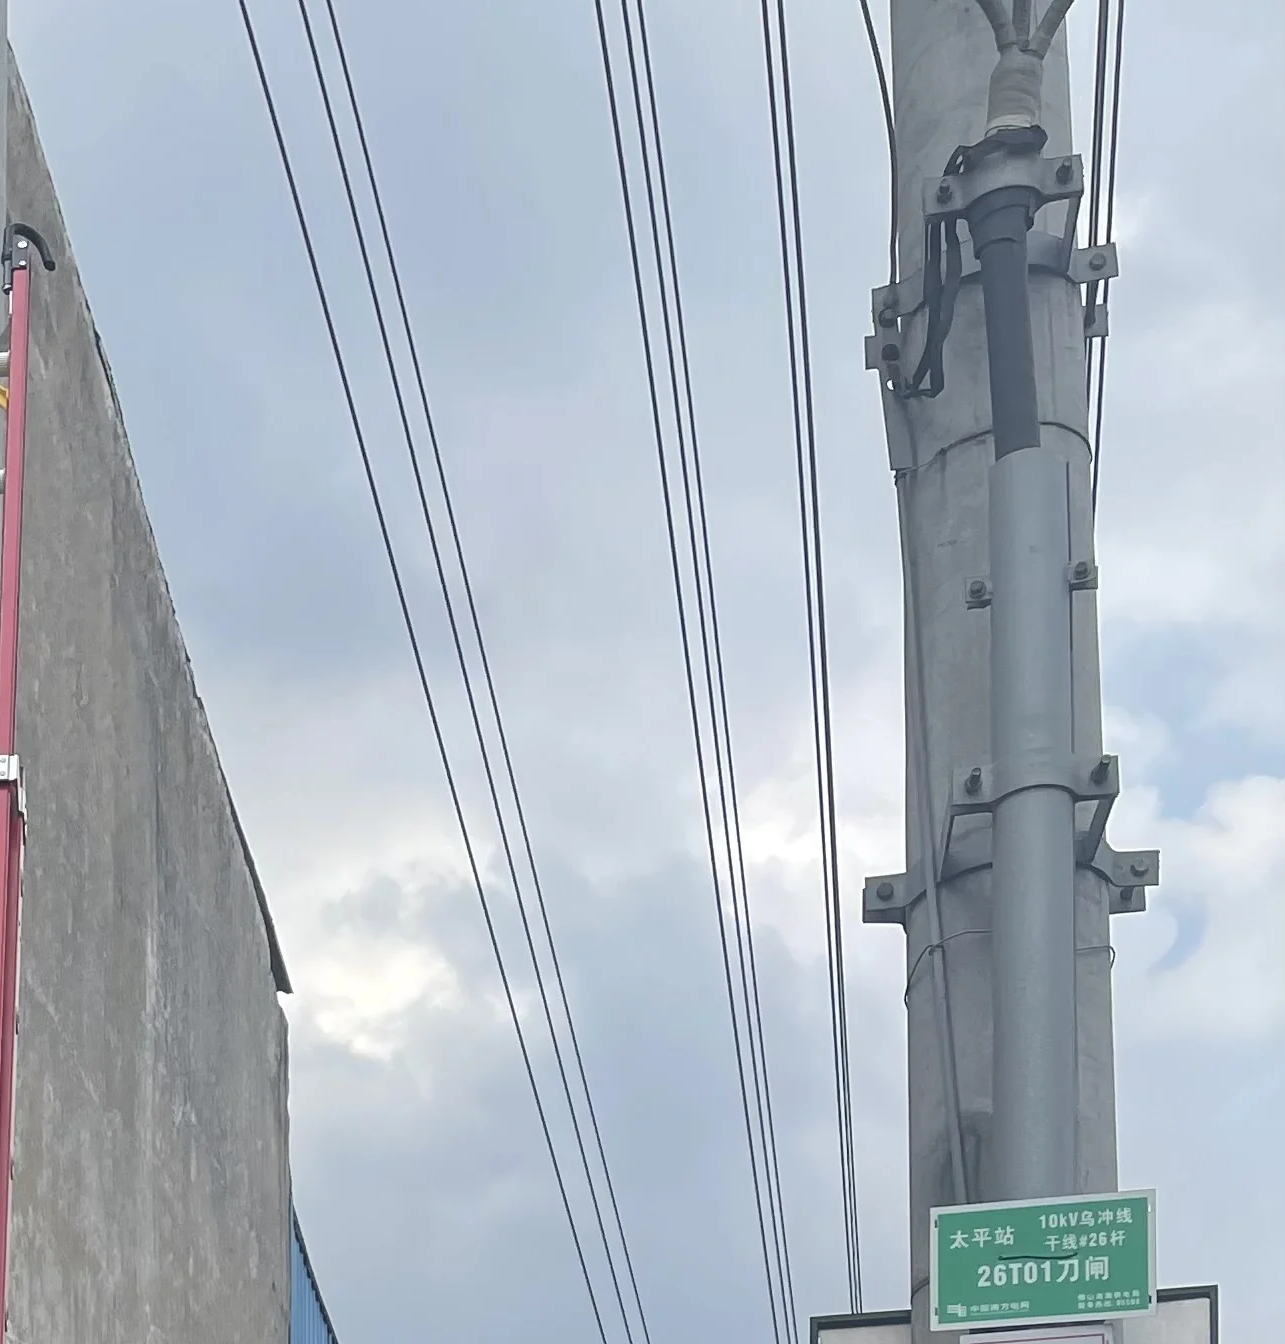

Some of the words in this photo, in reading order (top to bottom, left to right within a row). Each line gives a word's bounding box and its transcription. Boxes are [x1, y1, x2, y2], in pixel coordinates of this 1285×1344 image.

[1039, 1207, 1133, 1229] 10kV乌冲线
[950, 1226, 1015, 1249] 太平站
[977, 1256, 1109, 1287] 26T01刀闸
